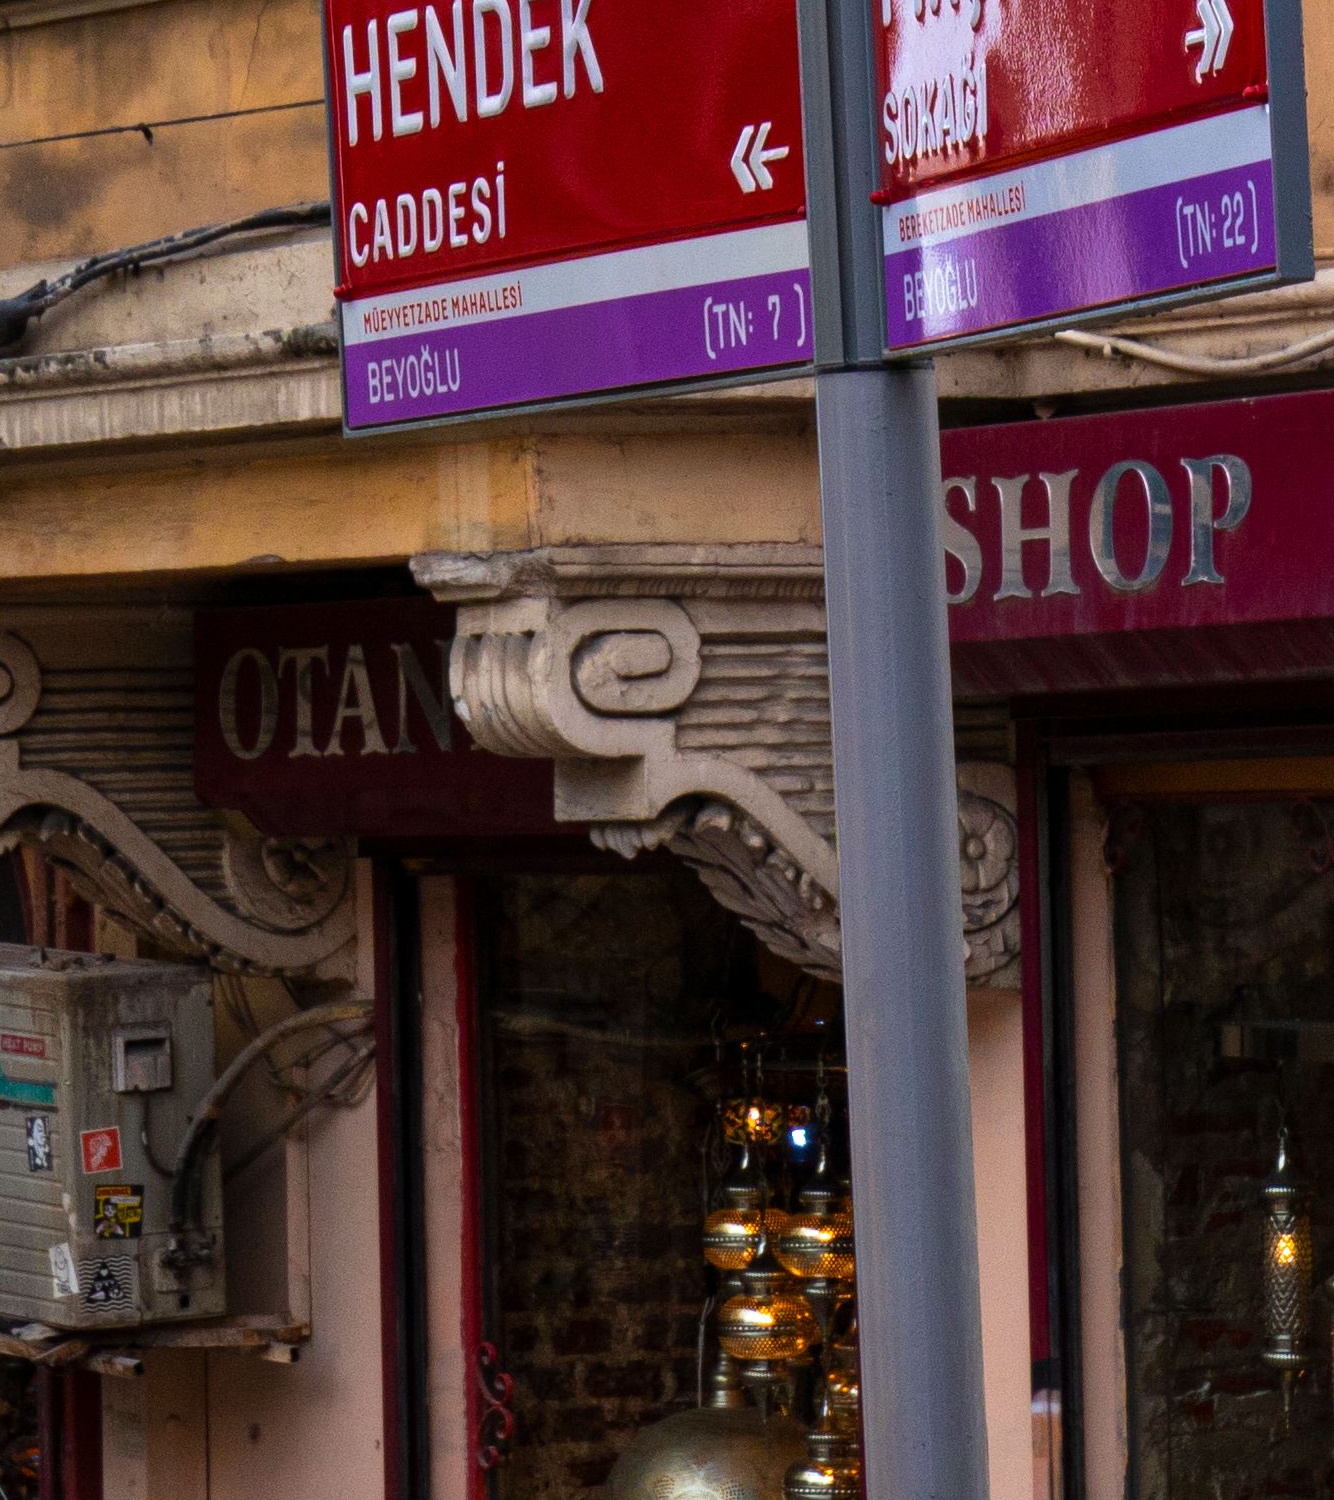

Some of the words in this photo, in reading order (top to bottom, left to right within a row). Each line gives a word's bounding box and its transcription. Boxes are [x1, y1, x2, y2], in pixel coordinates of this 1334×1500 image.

[883, 54, 987, 165] SOKAĞI
[349, 160, 506, 267] CADDESİ
[899, 202, 966, 242] BEREKETZADE
[967, 180, 1026, 224] MAHALLESİ
[362, 297, 449, 334] MÜEYYETZADE
[451, 280, 523, 320] MAHALLESİ
[903, 253, 978, 321] BEYOĞLU
[367, 344, 461, 404] BEYOĞLU
[942, 454, 1253, 604] SHOP
